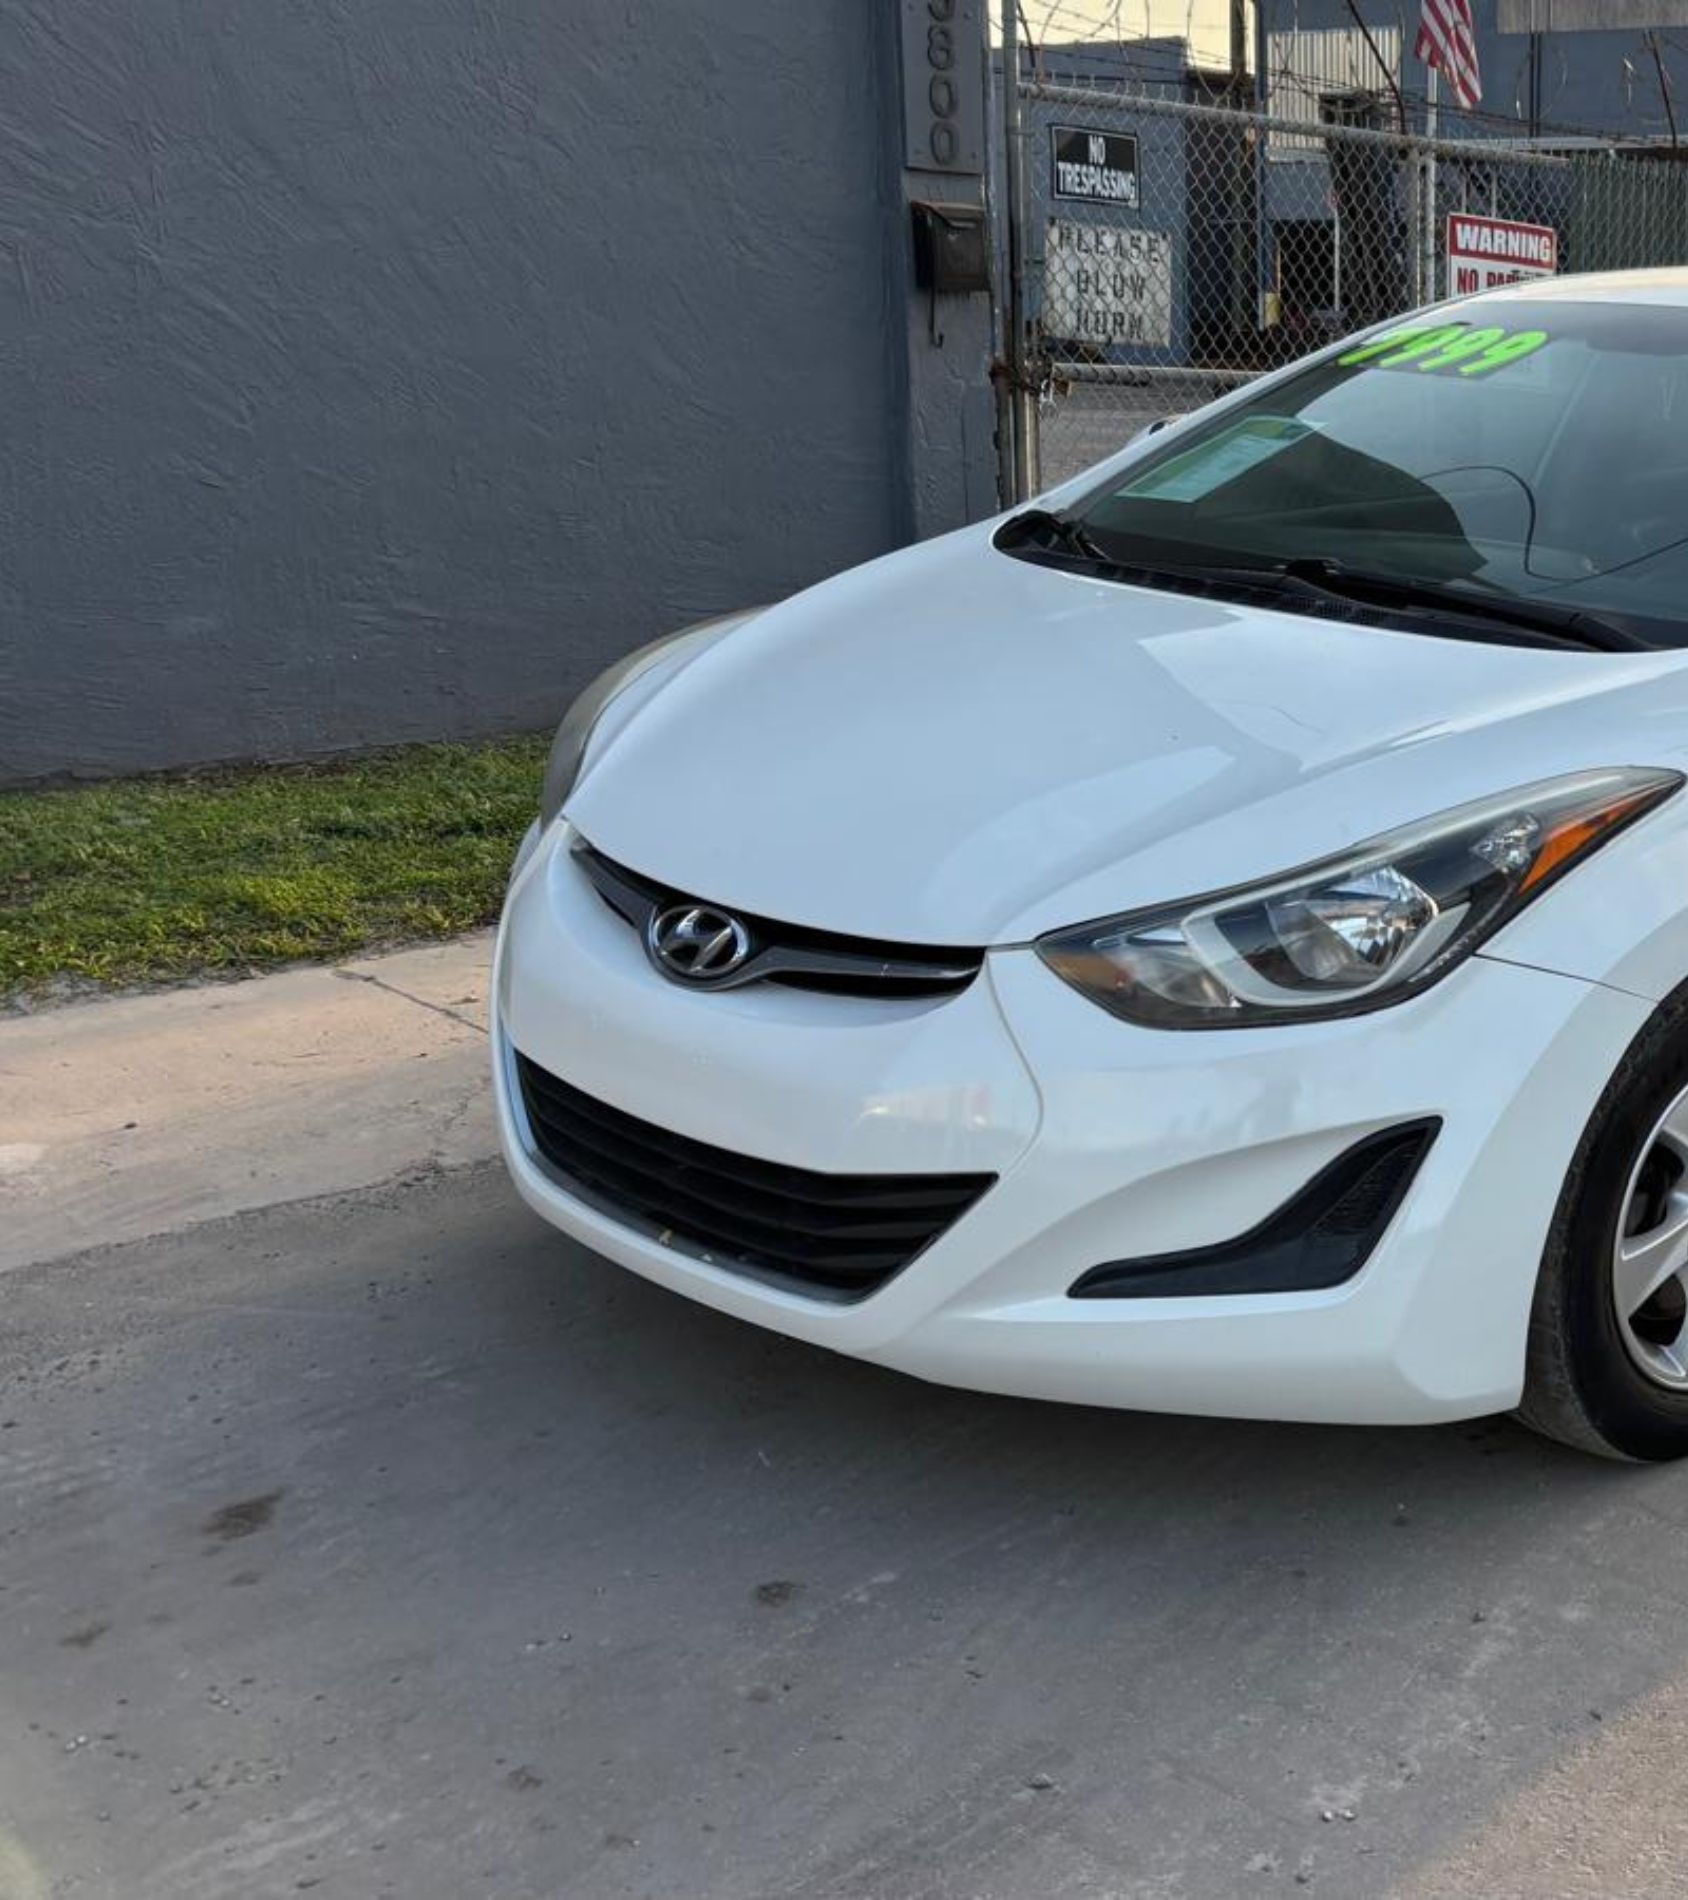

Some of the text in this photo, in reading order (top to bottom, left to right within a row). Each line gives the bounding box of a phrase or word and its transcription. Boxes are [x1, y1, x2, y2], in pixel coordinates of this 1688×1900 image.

[1088, 134, 1106, 165] NO
[1058, 161, 1136, 200] TRESPASSING
[1455, 222, 1552, 263] WARNING
[1457, 267, 1480, 296] NO
